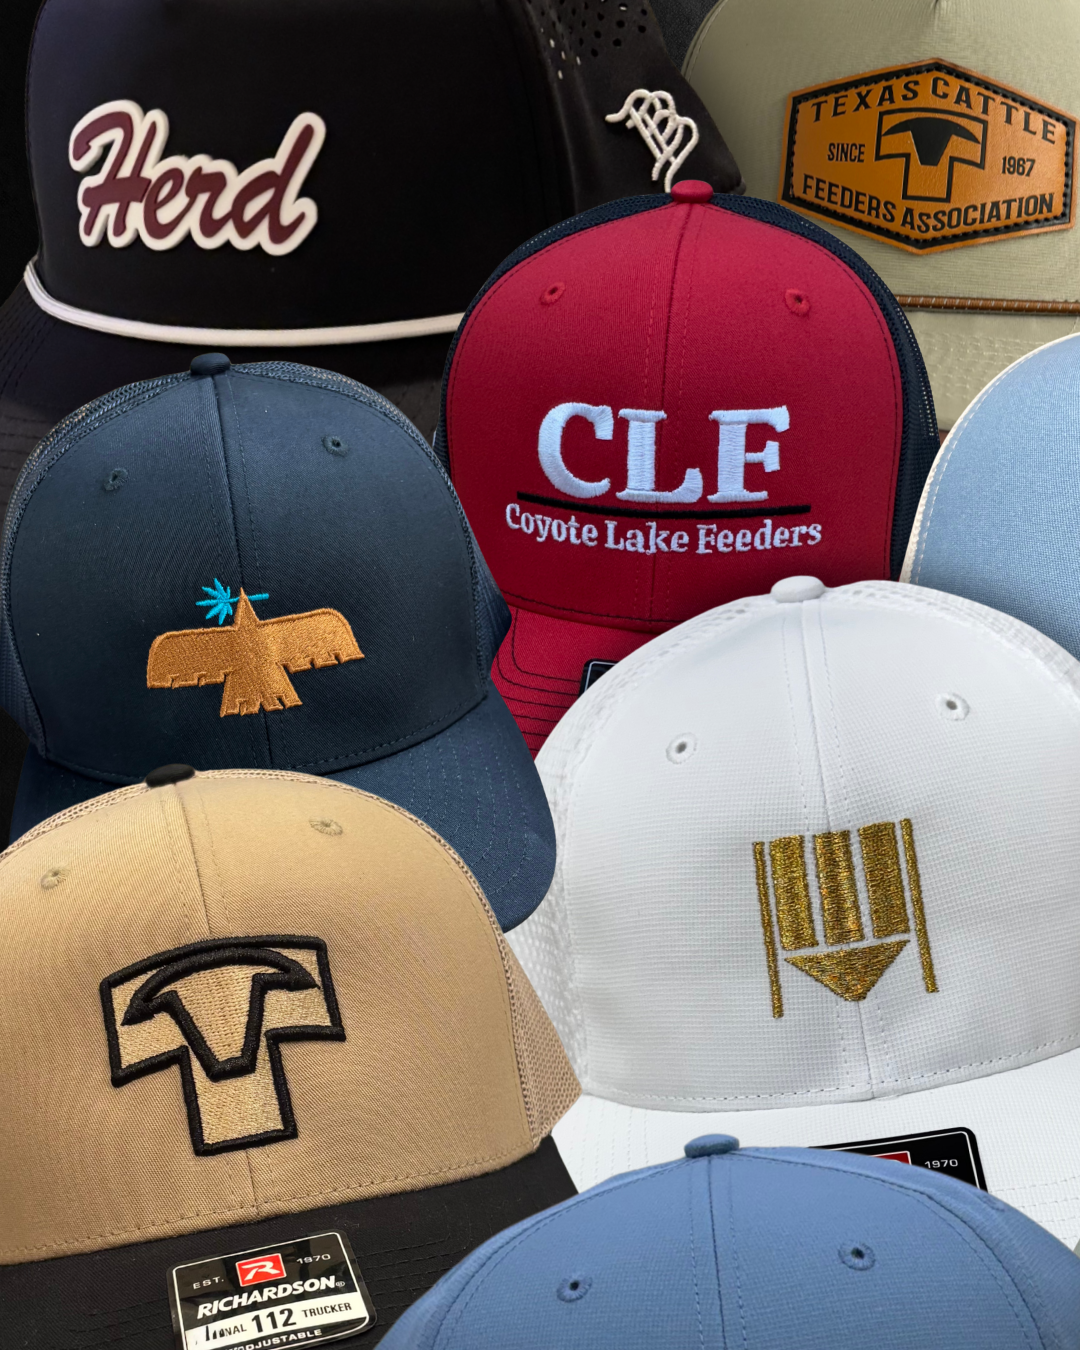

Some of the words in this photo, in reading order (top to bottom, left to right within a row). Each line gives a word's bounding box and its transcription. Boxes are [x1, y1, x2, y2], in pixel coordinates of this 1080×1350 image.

[811, 80, 919, 123] TEXAS
[931, 77, 1056, 144] CATTLE
[70, 101, 325, 255] Herd
[827, 143, 865, 163] SINCE
[1002, 156, 1036, 177] 1967
[803, 173, 896, 223] FEEDERS
[901, 193, 1055, 234] ASSOCIATION
[538, 402, 790, 503] CLF
[505, 503, 598, 546] Coyote
[604, 521, 689, 555] Lake
[696, 519, 822, 555] Feeders
[924, 1159, 959, 1169] 1970
[193, 1276, 225, 1290] EST.
[296, 1254, 331, 1265] 1970
[251, 1308, 297, 1334] 112
[301, 1302, 352, 1318] TRUCKER
